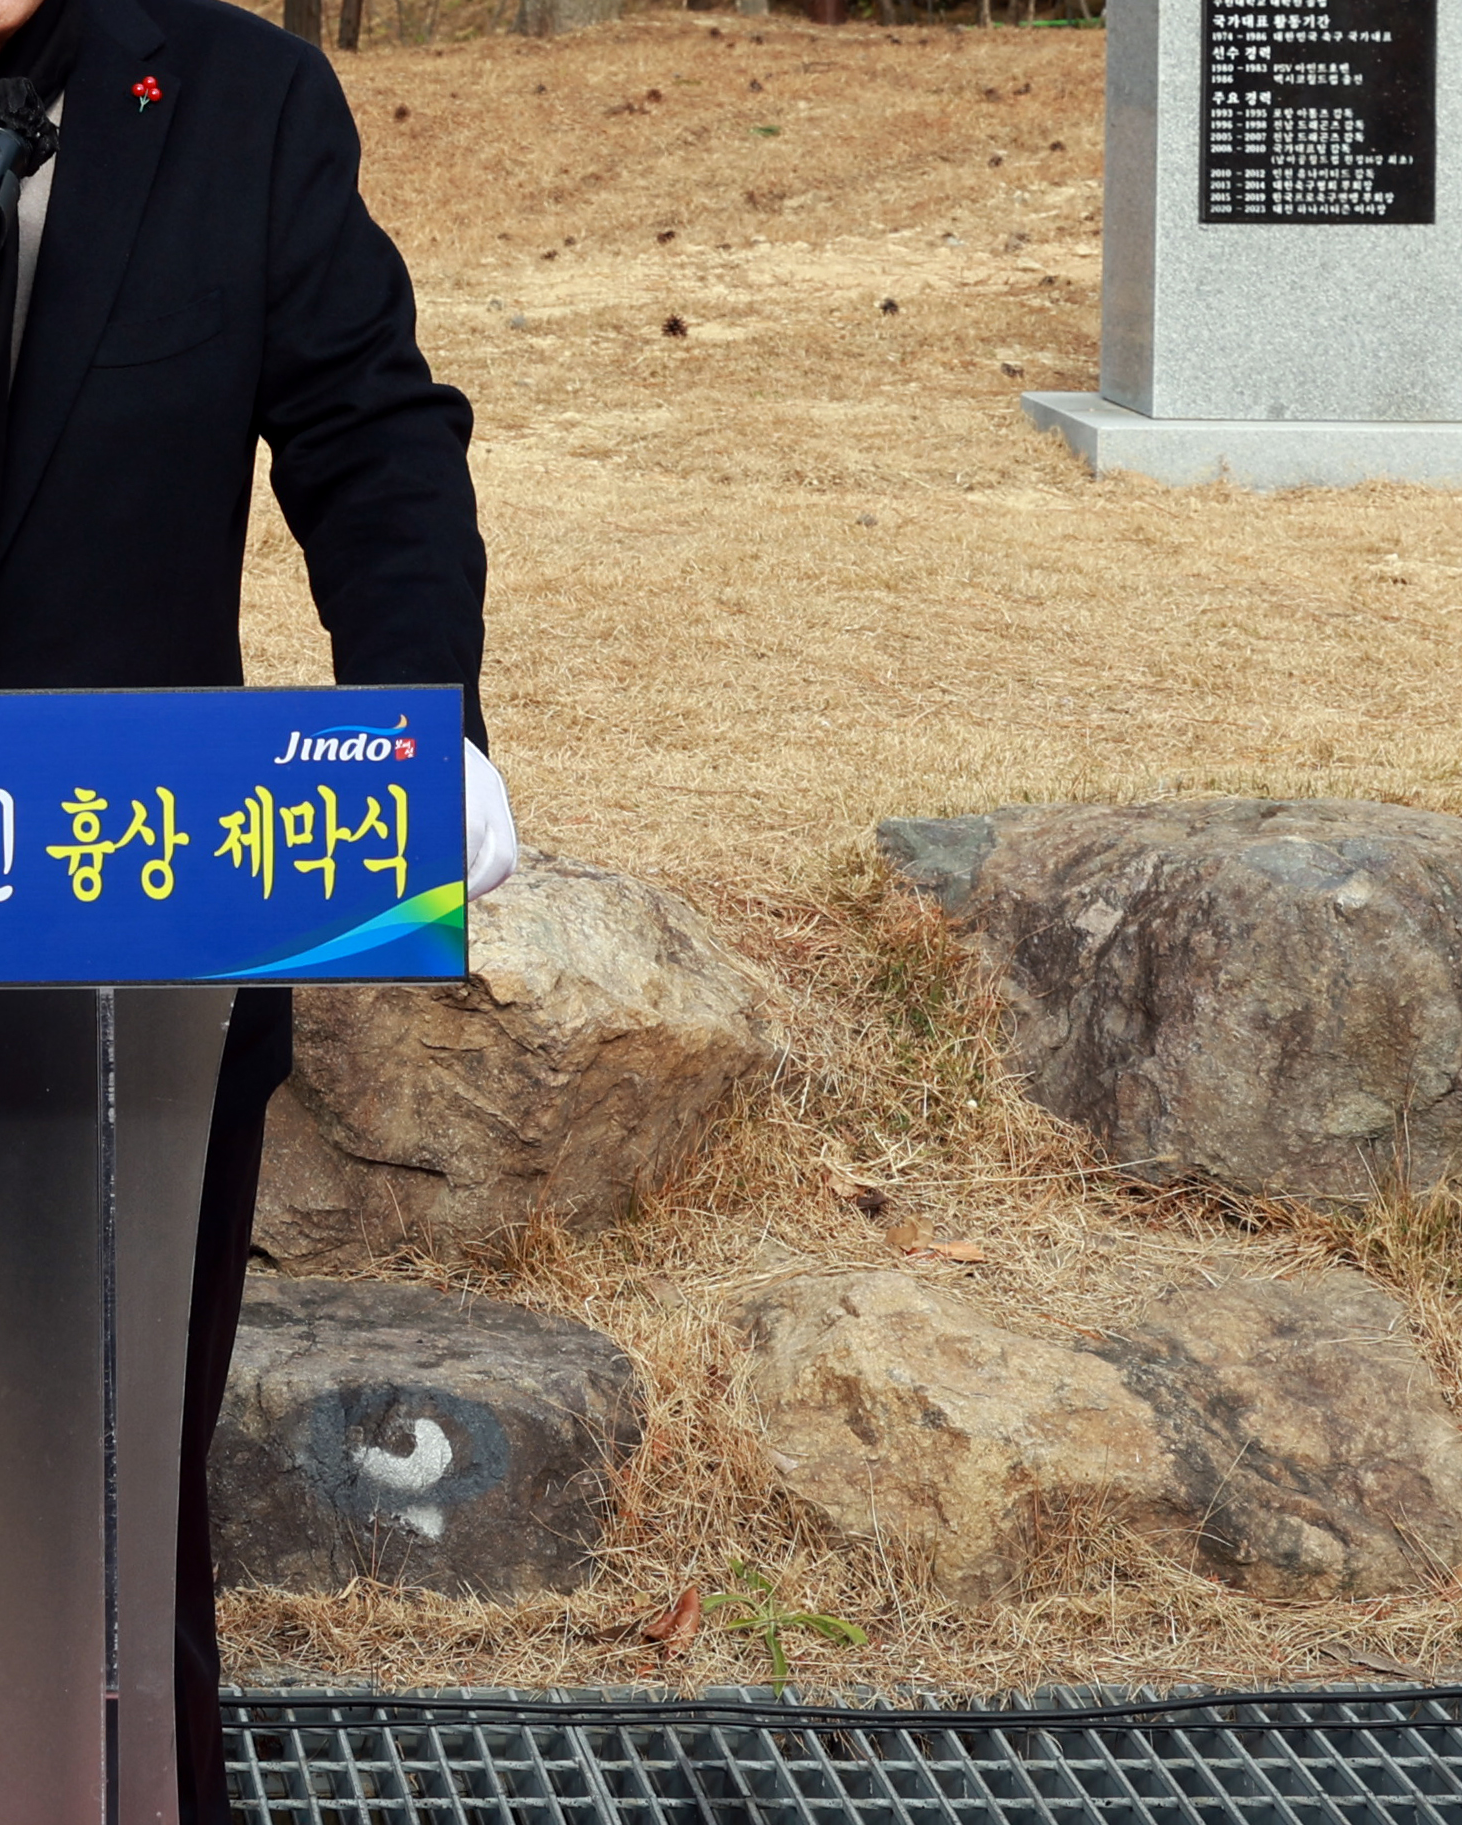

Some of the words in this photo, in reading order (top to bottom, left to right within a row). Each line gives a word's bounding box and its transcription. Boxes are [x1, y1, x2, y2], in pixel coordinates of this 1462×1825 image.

[1212, 13, 1269, 28] 국가대표
[1273, 13, 1331, 29] 활동기간
[1321, 31, 1344, 41] 축구
[1347, 30, 1392, 42] 국가대표
[1212, 45, 1240, 60] 선수
[1244, 45, 1272, 60] 경력
[1212, 91, 1240, 105] 주요
[1245, 90, 1272, 106] 경력
[275, 731, 391, 764] Jindo
[46, 787, 189, 901] 흉상
[214, 784, 407, 899] 제막식
